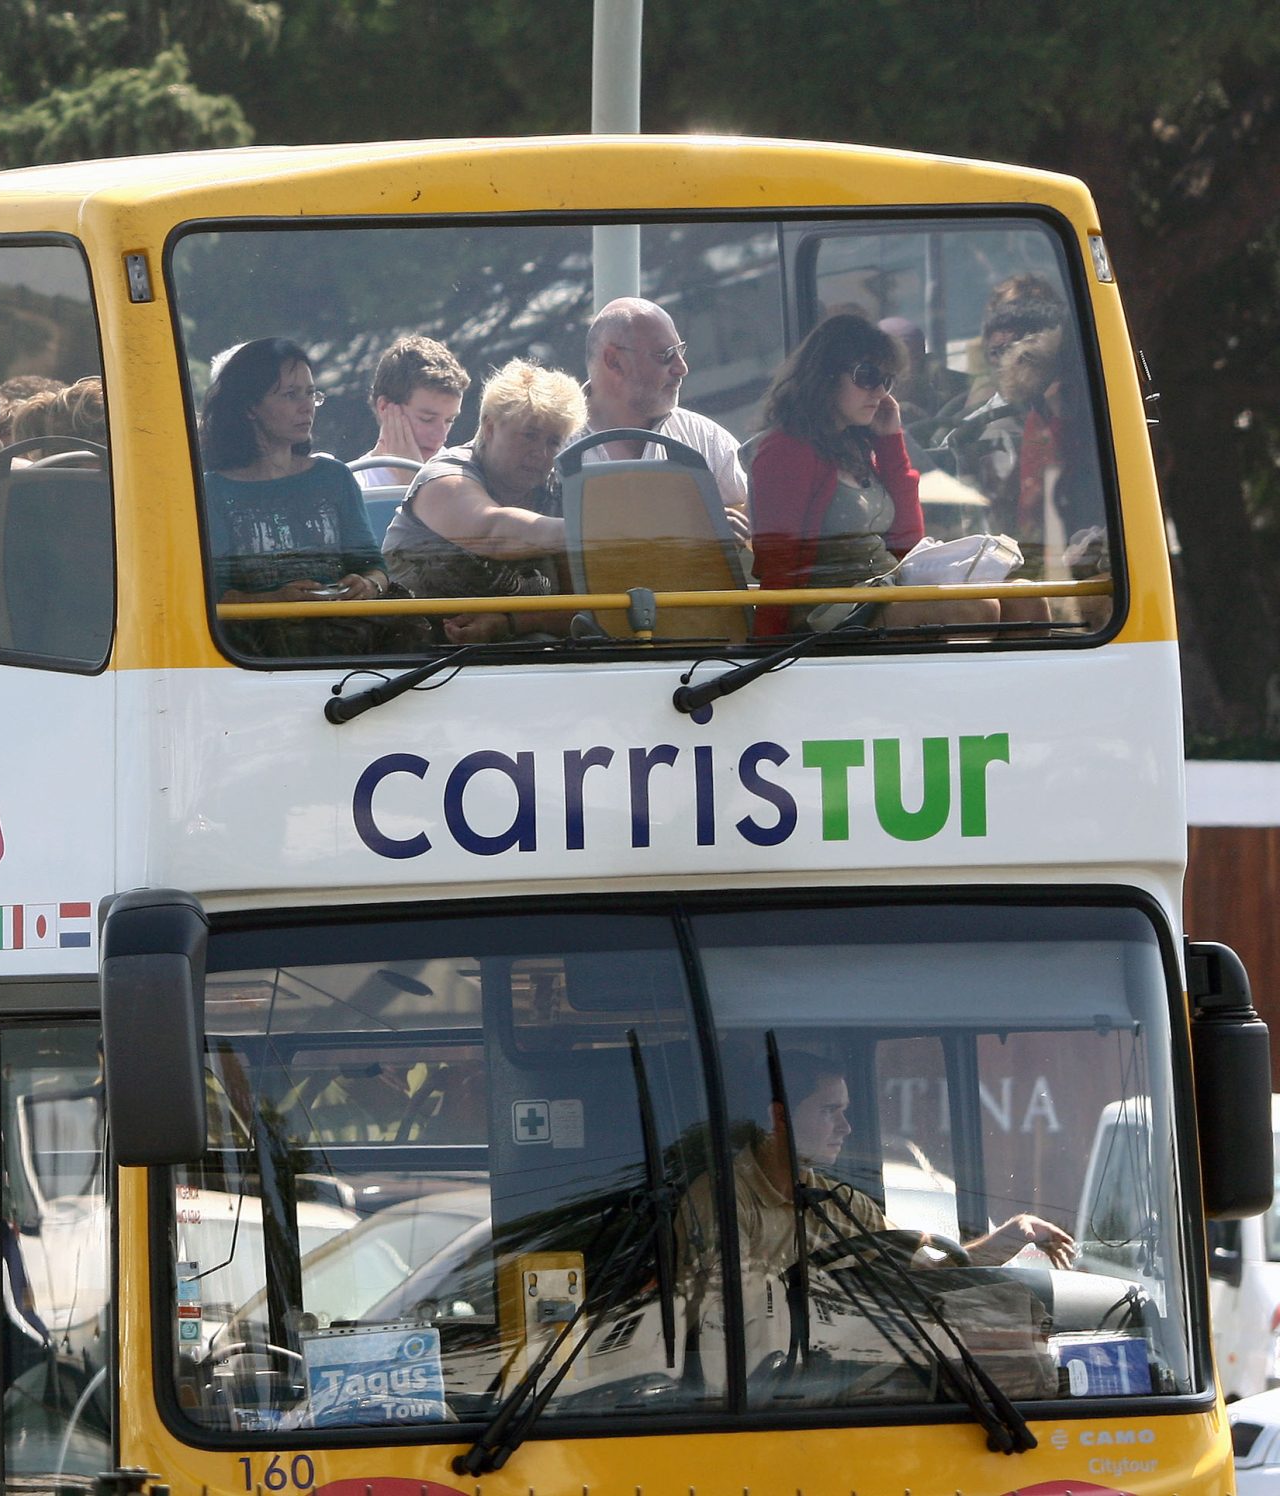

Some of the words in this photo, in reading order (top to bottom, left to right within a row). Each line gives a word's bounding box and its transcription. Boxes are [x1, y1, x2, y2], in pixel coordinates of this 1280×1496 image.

[382, 1402, 433, 1420] Tour
[1079, 1429, 1156, 1446] CAMO
[239, 1455, 315, 1491] 160
[1088, 1457, 1159, 1477] Citytour
